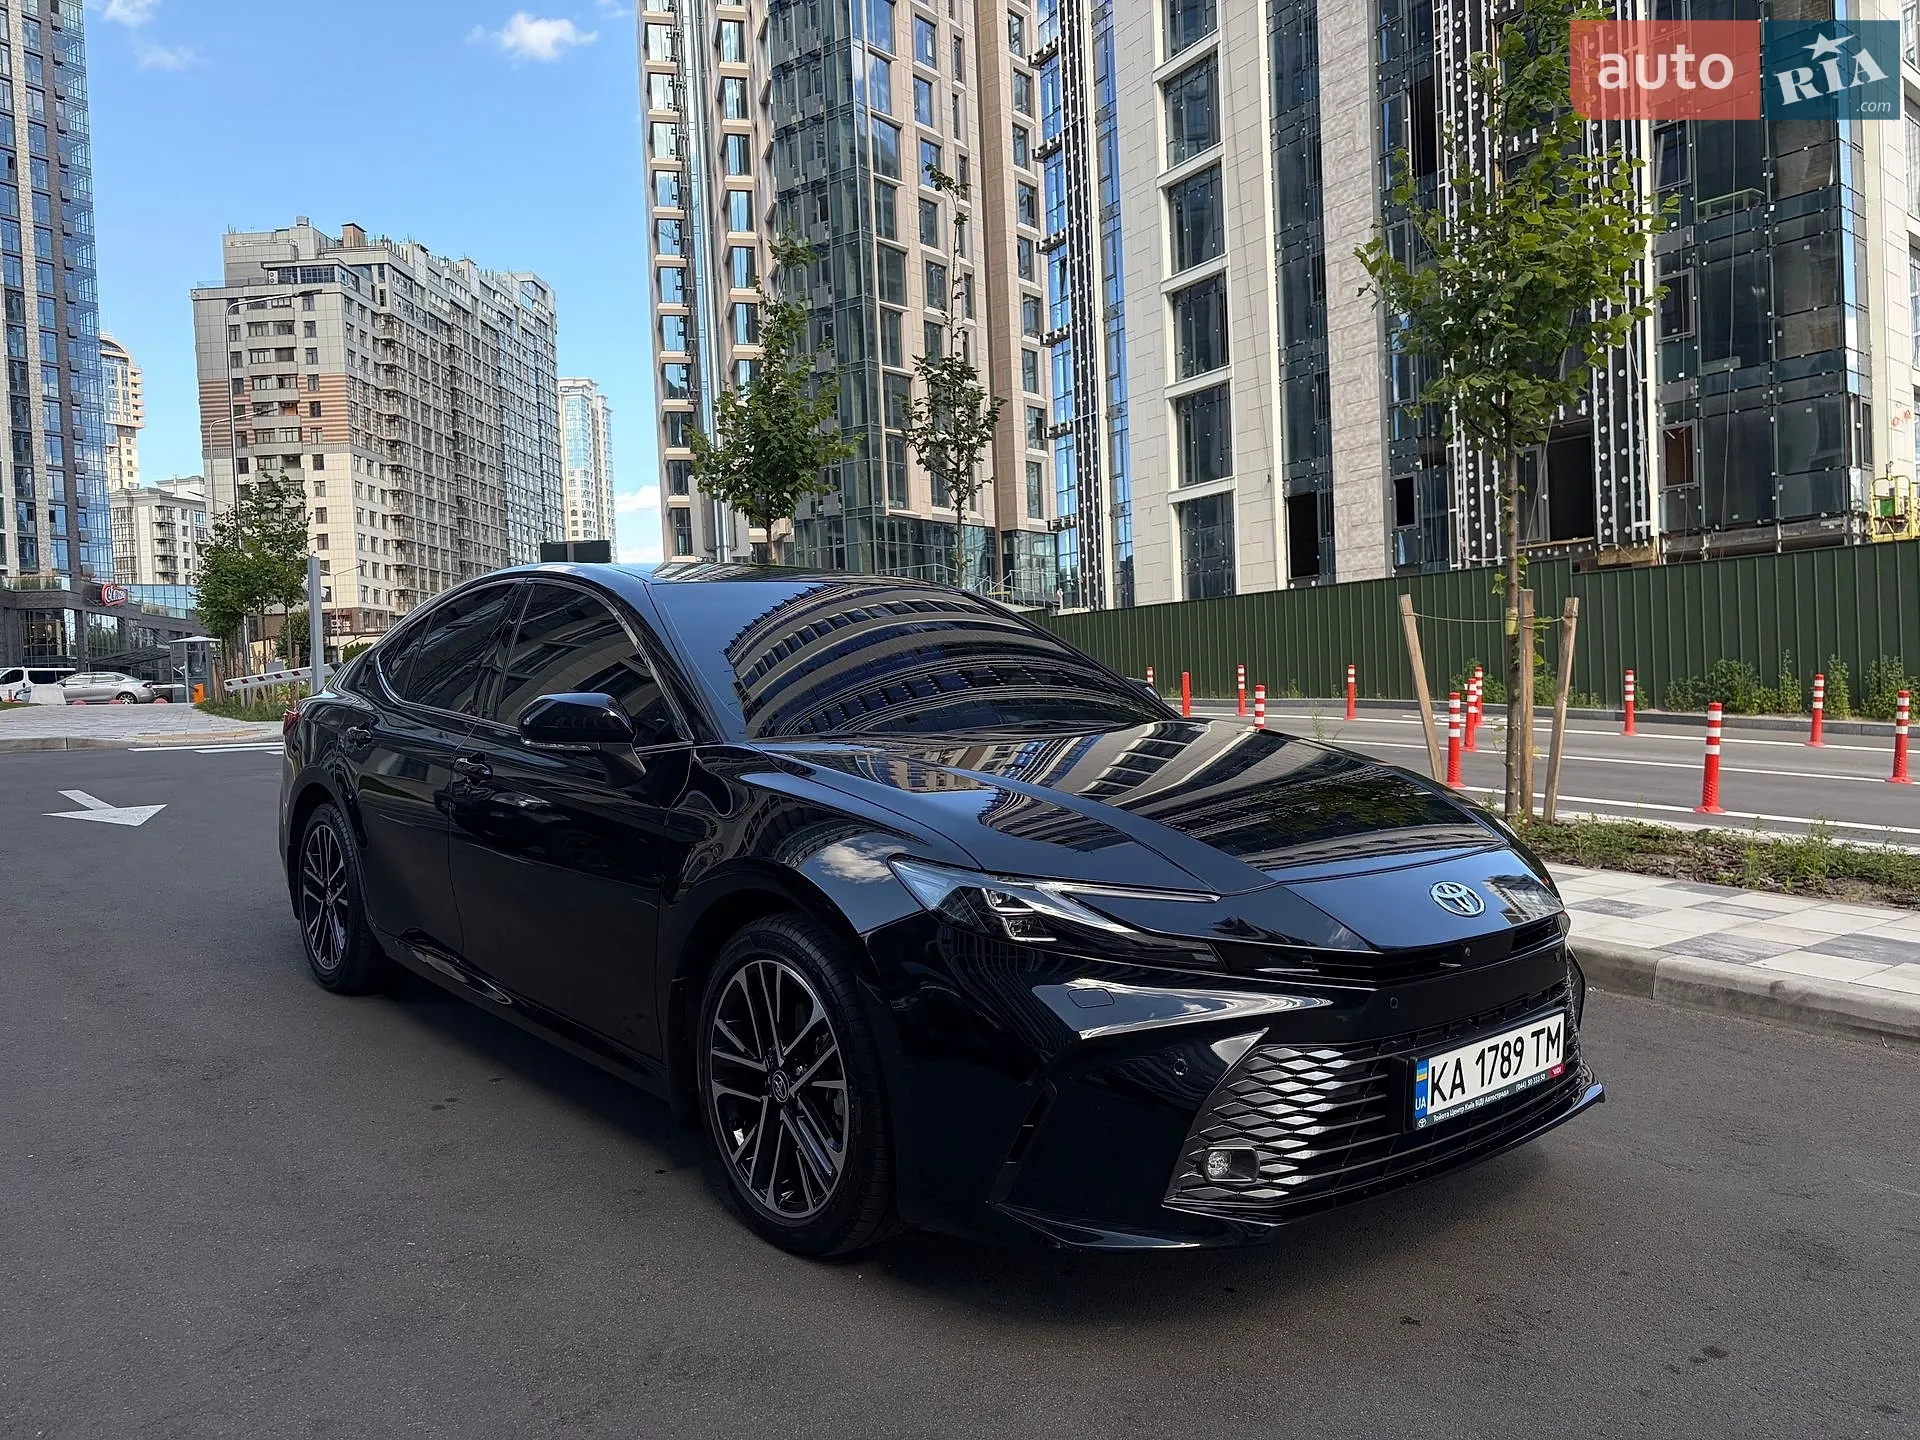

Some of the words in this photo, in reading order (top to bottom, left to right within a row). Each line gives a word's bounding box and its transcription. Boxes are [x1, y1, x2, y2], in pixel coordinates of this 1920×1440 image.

[1430, 1057, 1465, 1106] KA
[1475, 1036, 1525, 1088] 1789
[1531, 1022, 1562, 1067] TM
[1415, 1095, 1426, 1111] UA
